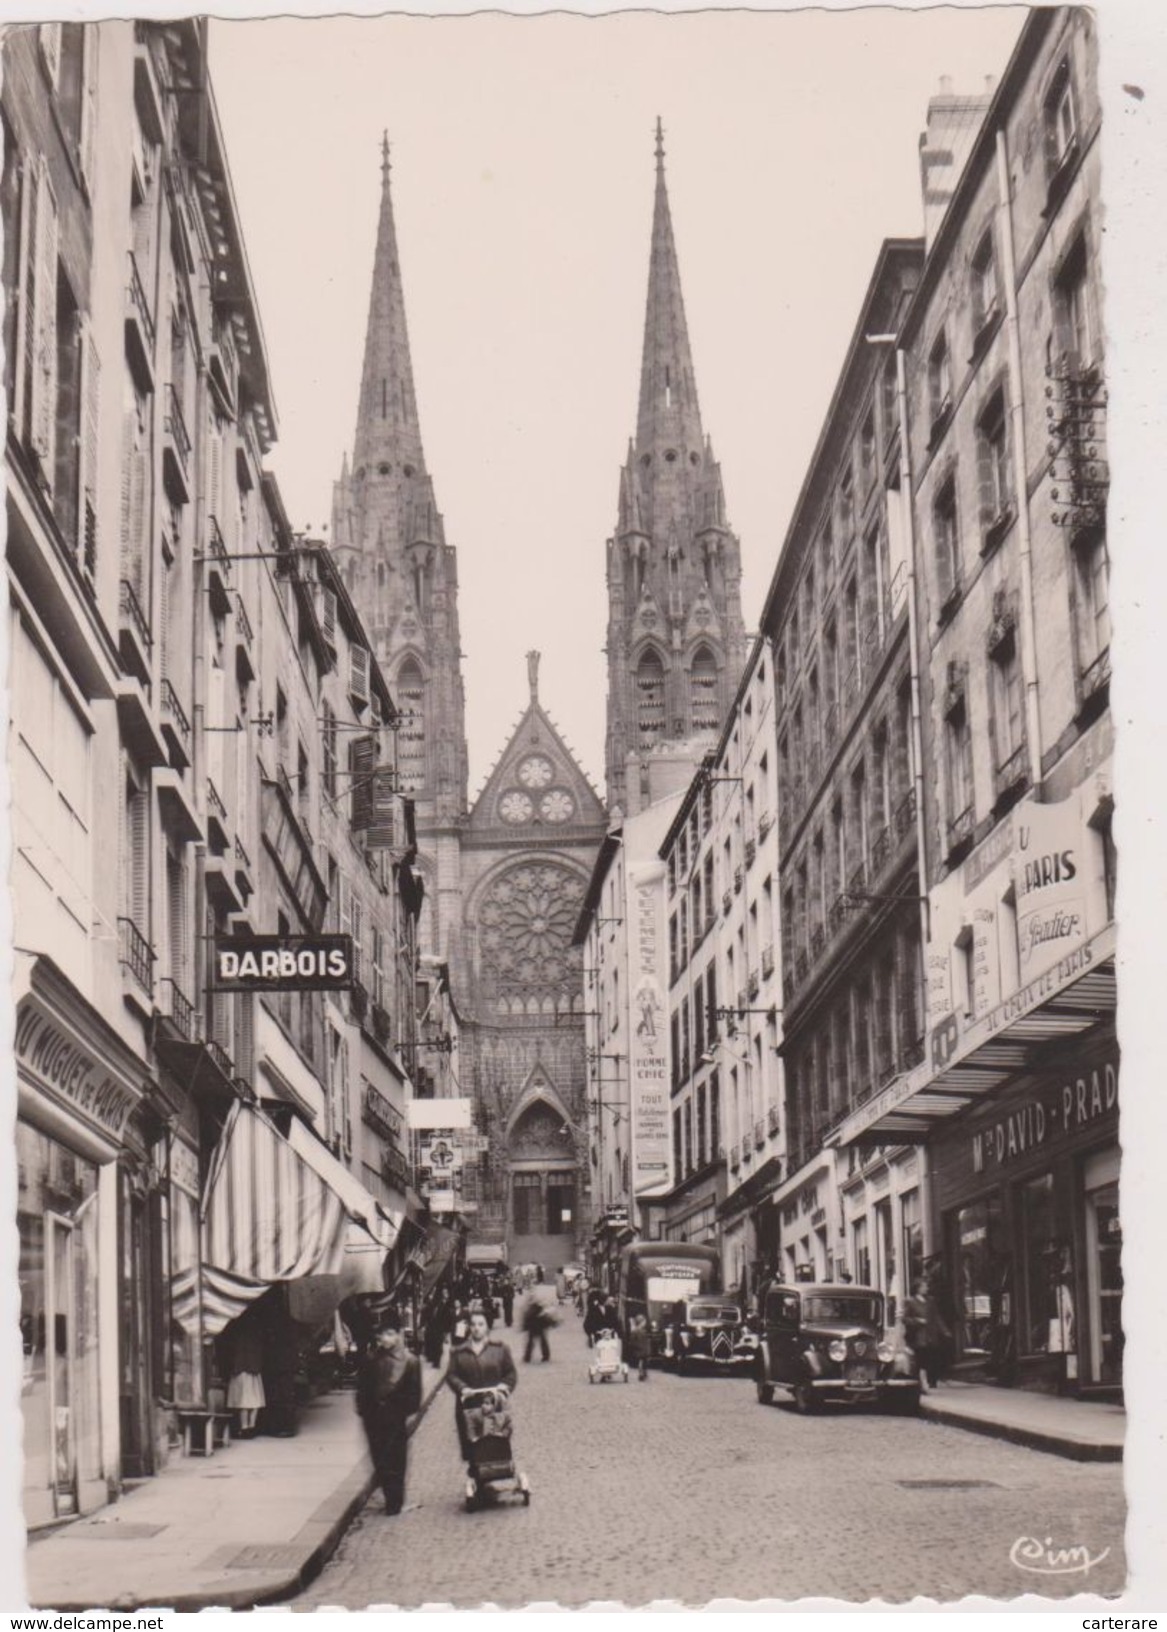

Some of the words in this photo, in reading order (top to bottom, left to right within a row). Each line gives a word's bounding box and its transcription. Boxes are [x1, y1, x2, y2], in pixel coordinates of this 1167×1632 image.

[1024, 849, 1077, 894] PARIS
[220, 951, 347, 978] DARBOIS
[1057, 942, 1093, 984] PARIS
[32, 1024, 95, 1101] MUGUET
[92, 1077, 133, 1132] PARIS
[996, 1101, 1045, 1163] DAVID
[1063, 1063, 1116, 1131] PRAD
